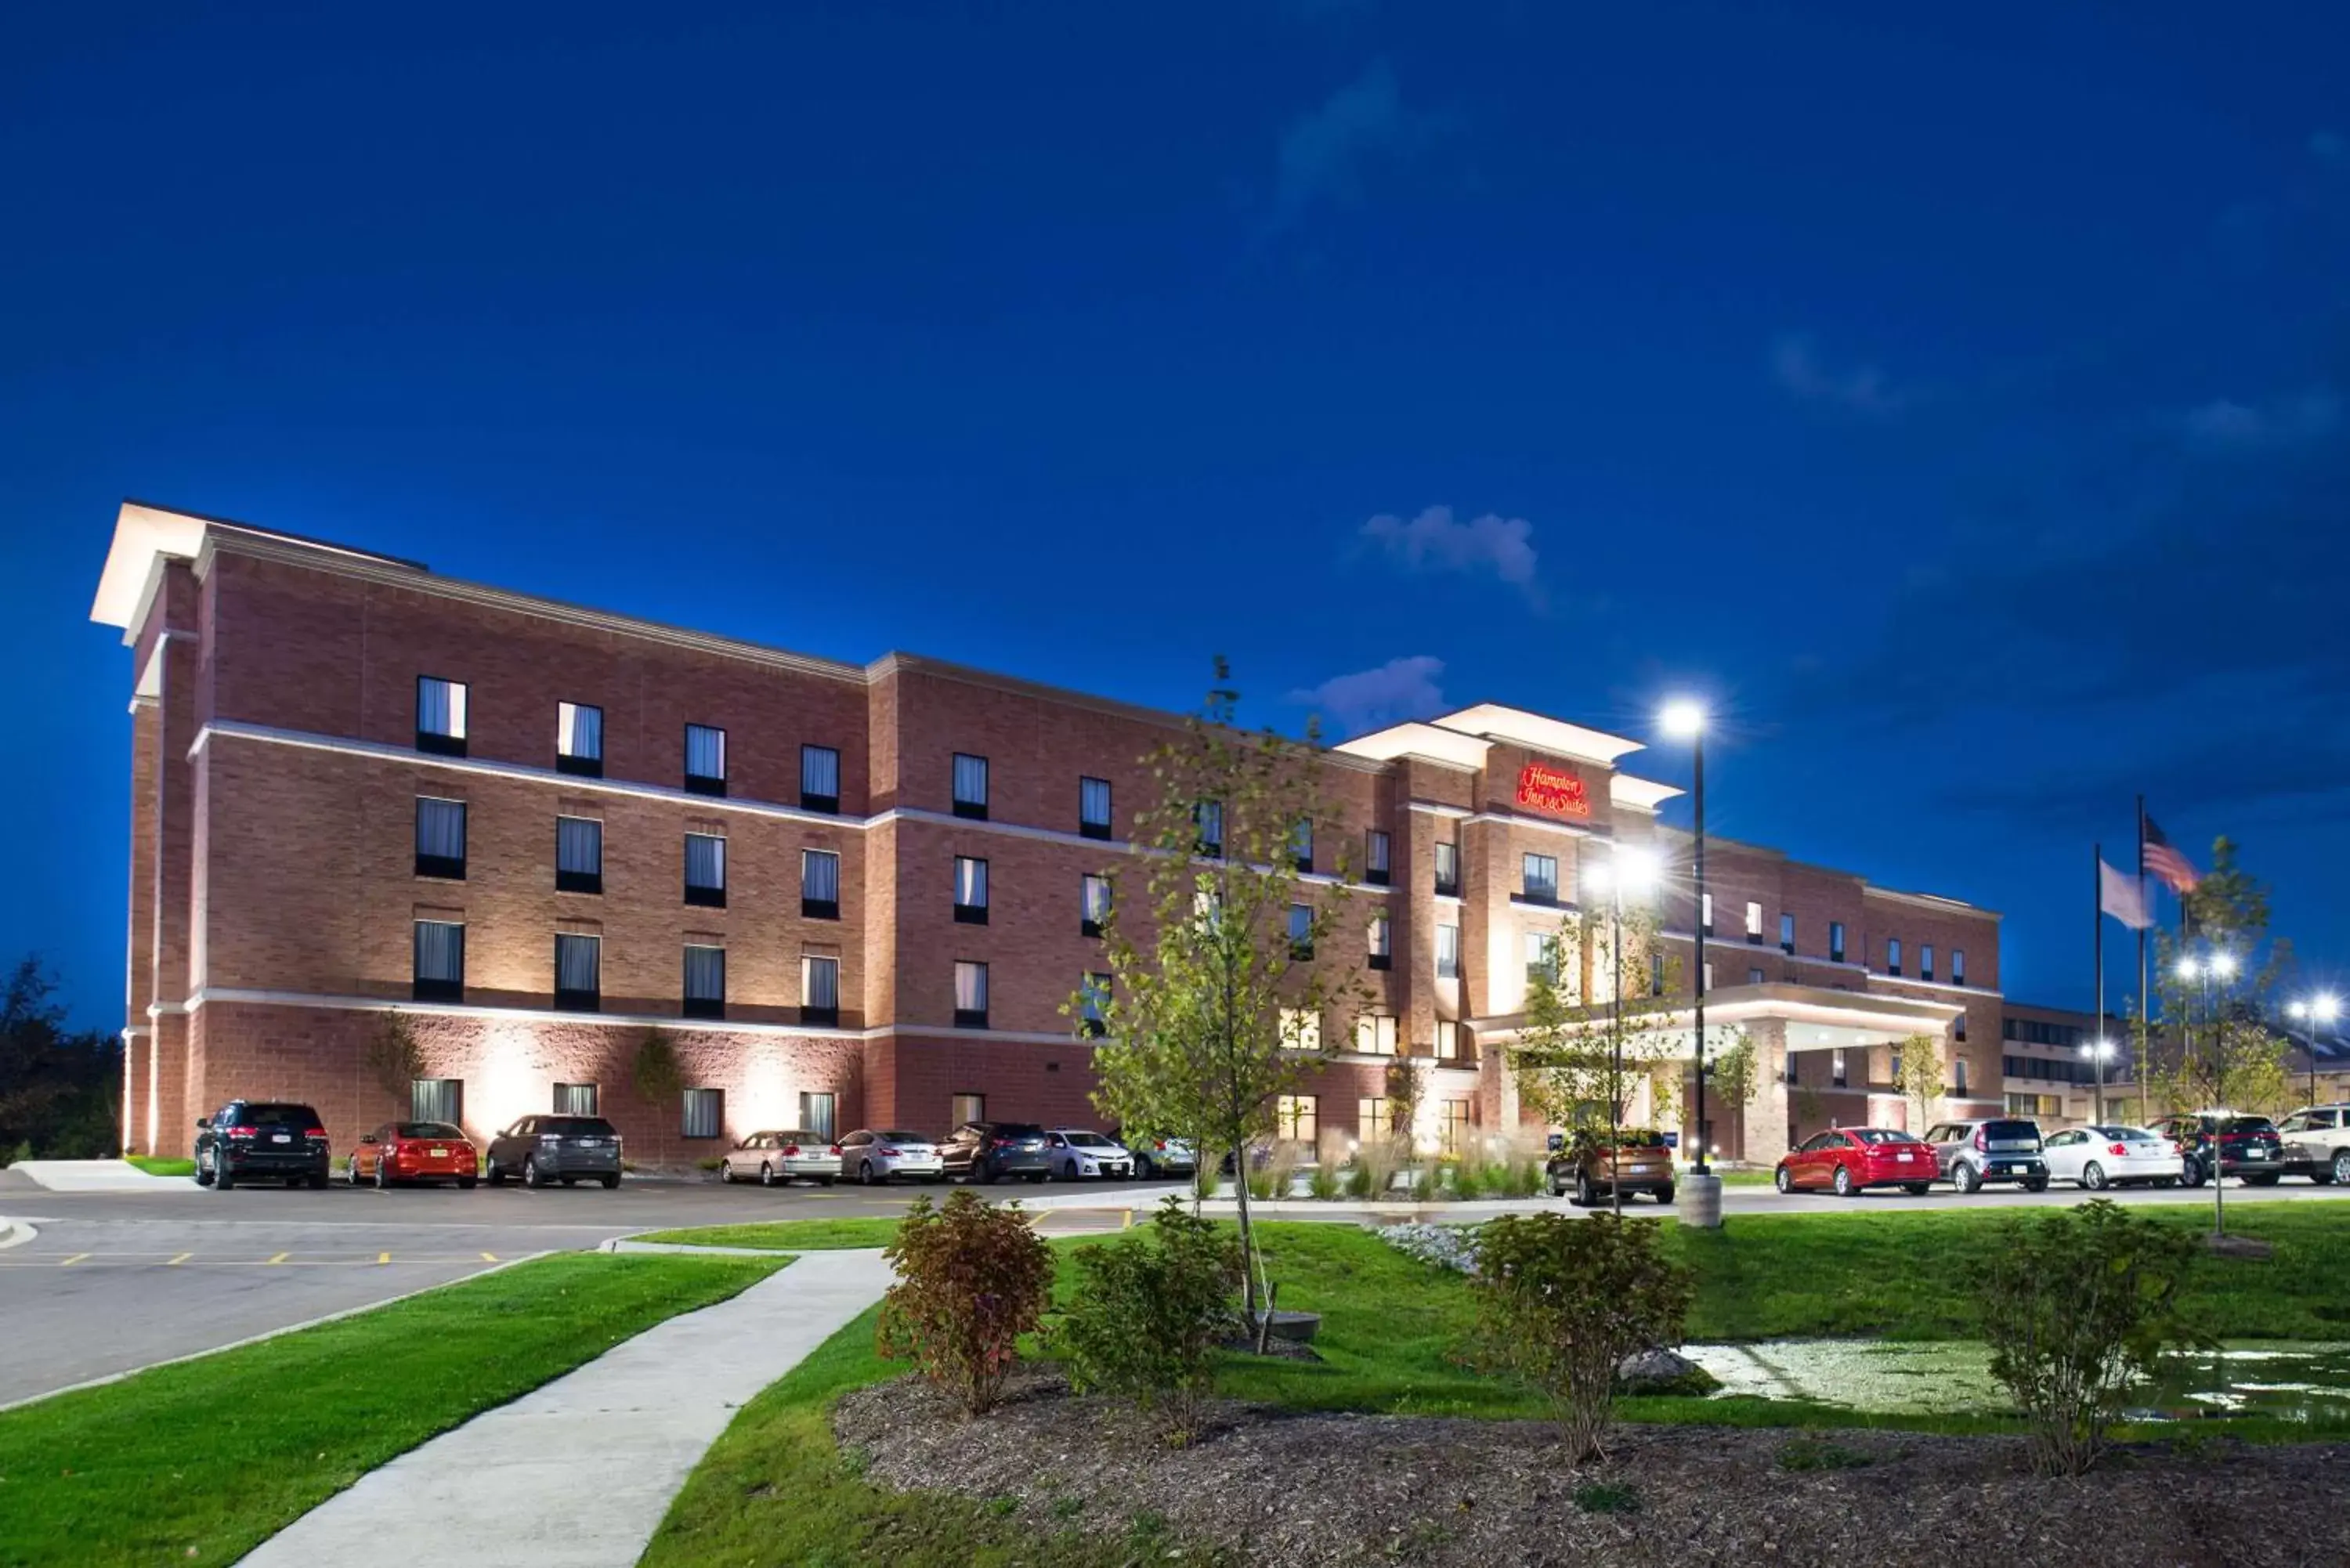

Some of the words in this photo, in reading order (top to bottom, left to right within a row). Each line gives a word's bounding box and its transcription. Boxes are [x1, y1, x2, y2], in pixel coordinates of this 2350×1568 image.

[1523, 767, 1583, 797] Hampton
[1518, 788, 1549, 809] Inn
[1557, 794, 1588, 815] Suites
